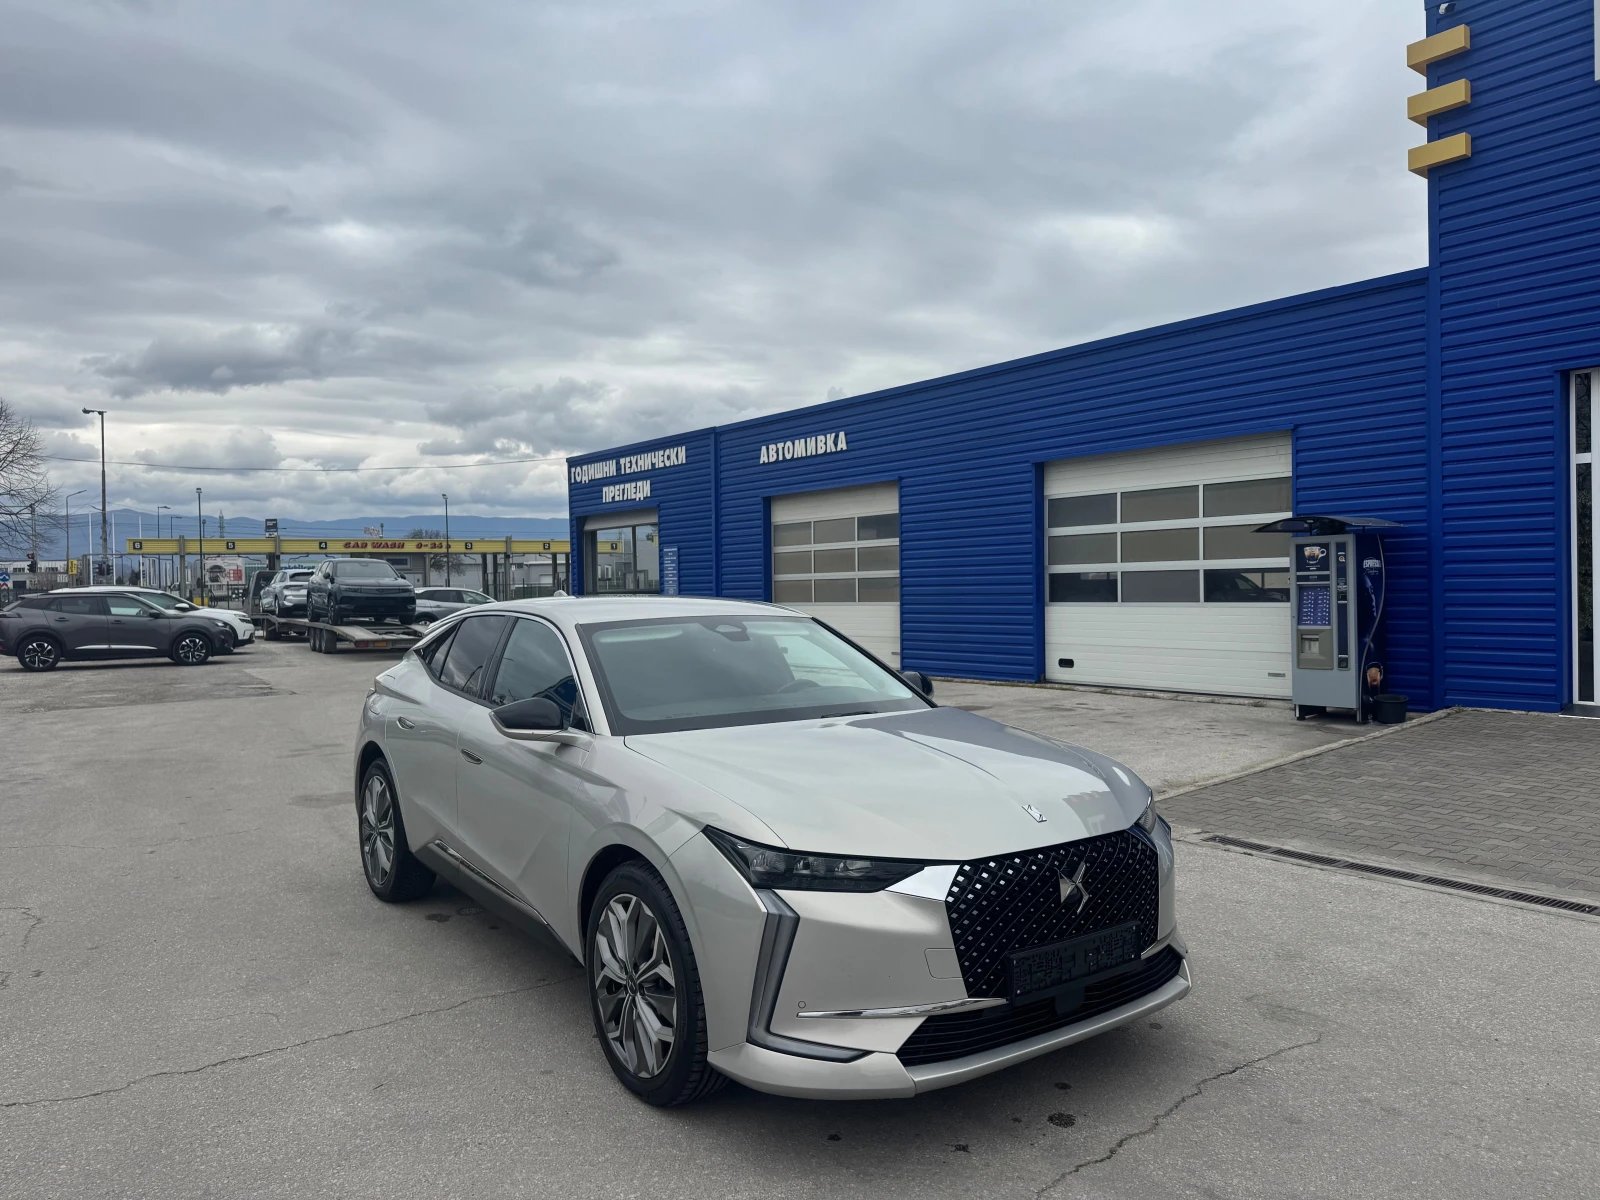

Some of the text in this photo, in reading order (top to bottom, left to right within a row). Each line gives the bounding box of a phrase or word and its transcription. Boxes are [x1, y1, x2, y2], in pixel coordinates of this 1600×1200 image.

[760, 431, 847, 464] АВТОМИВКА
[571, 445, 686, 484] ГОДИШНИ ТЕХНИЧЕСКИ
[602, 480, 650, 503] ПРЕГЛЕДИ
